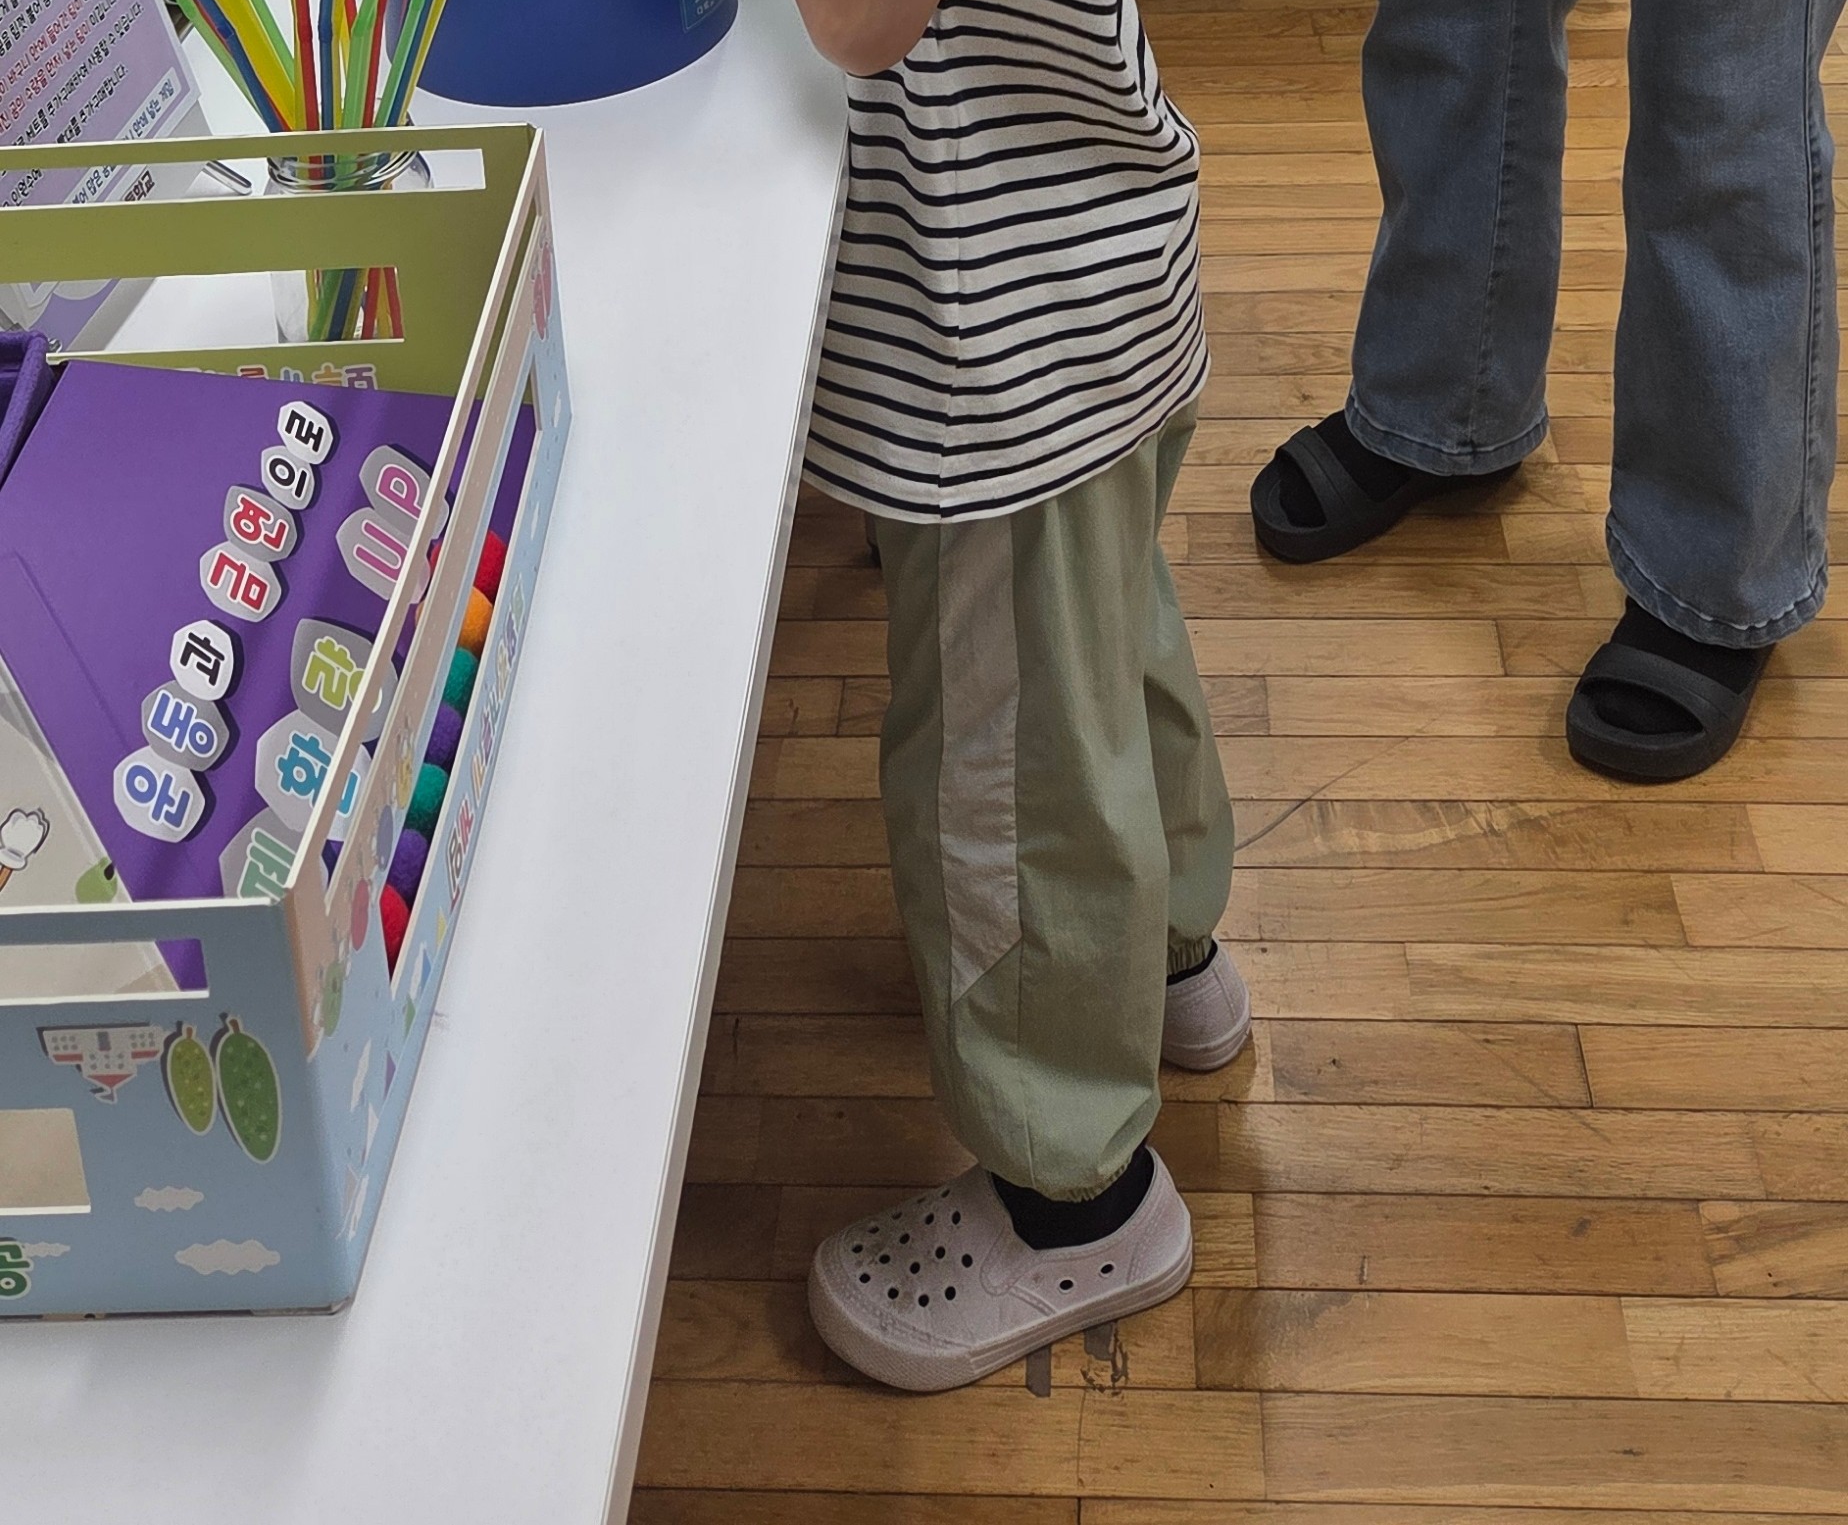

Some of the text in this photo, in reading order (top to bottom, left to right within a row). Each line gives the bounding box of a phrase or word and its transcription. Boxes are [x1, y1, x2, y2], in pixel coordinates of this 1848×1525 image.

[7, 54, 31, 84] 바구니
[29, 35, 48, 61] 안에
[46, 12, 72, 44] 들어간
[26, 109, 48, 141] 세트를
[88, 39, 109, 69] 사용할
[109, 33, 116, 44] 수
[114, 2, 144, 38] 있습니다.
[159, 79, 174, 101] 게임
[354, 464, 427, 583] UP
[124, 630, 225, 828] 운동과
[208, 409, 325, 613] 금연으로
